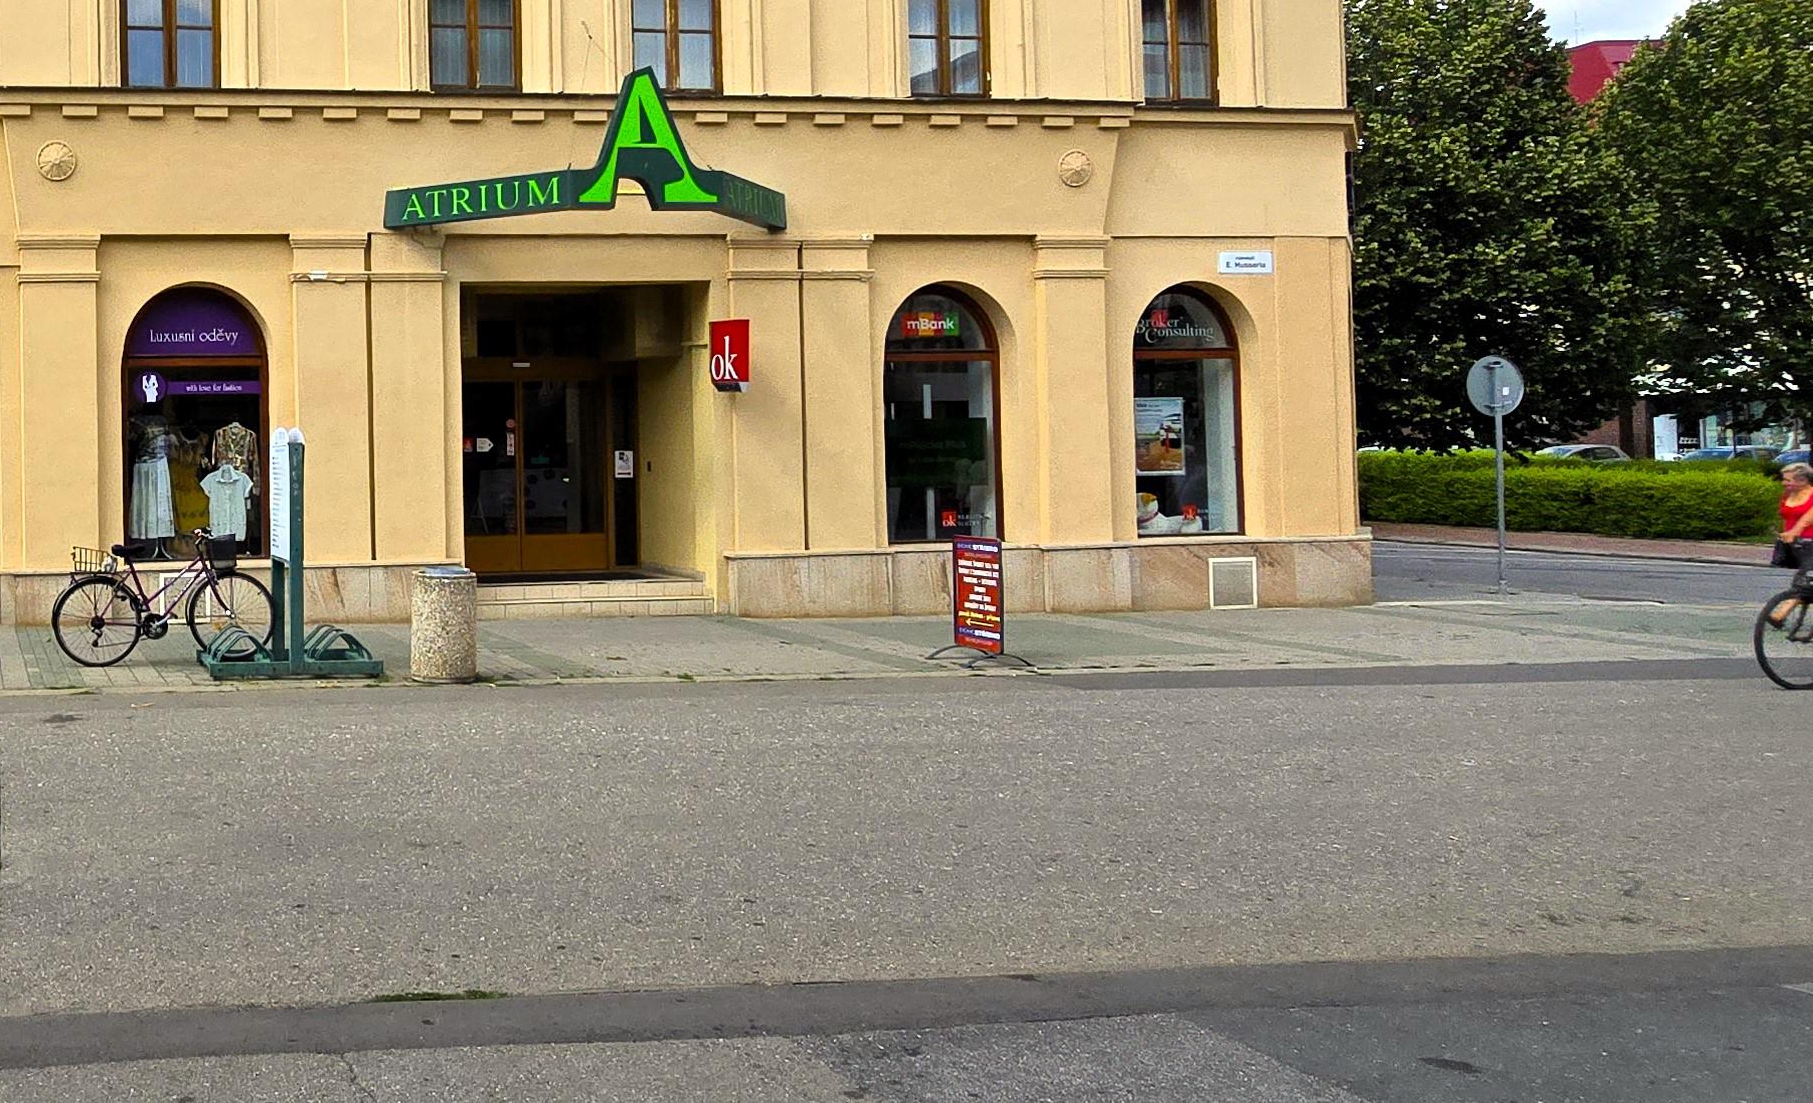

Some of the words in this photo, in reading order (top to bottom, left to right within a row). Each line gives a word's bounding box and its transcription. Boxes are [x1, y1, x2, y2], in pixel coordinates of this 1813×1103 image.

[579, 74, 718, 203] A
[402, 176, 561, 220] ATRIUM
[727, 181, 784, 223] ATRIUM
[150, 329, 195, 343] Luxusní
[198, 328, 239, 346] oděvy
[907, 317, 955, 330] mBank
[1145, 323, 1215, 343] Consulting
[711, 335, 739, 381] ok
